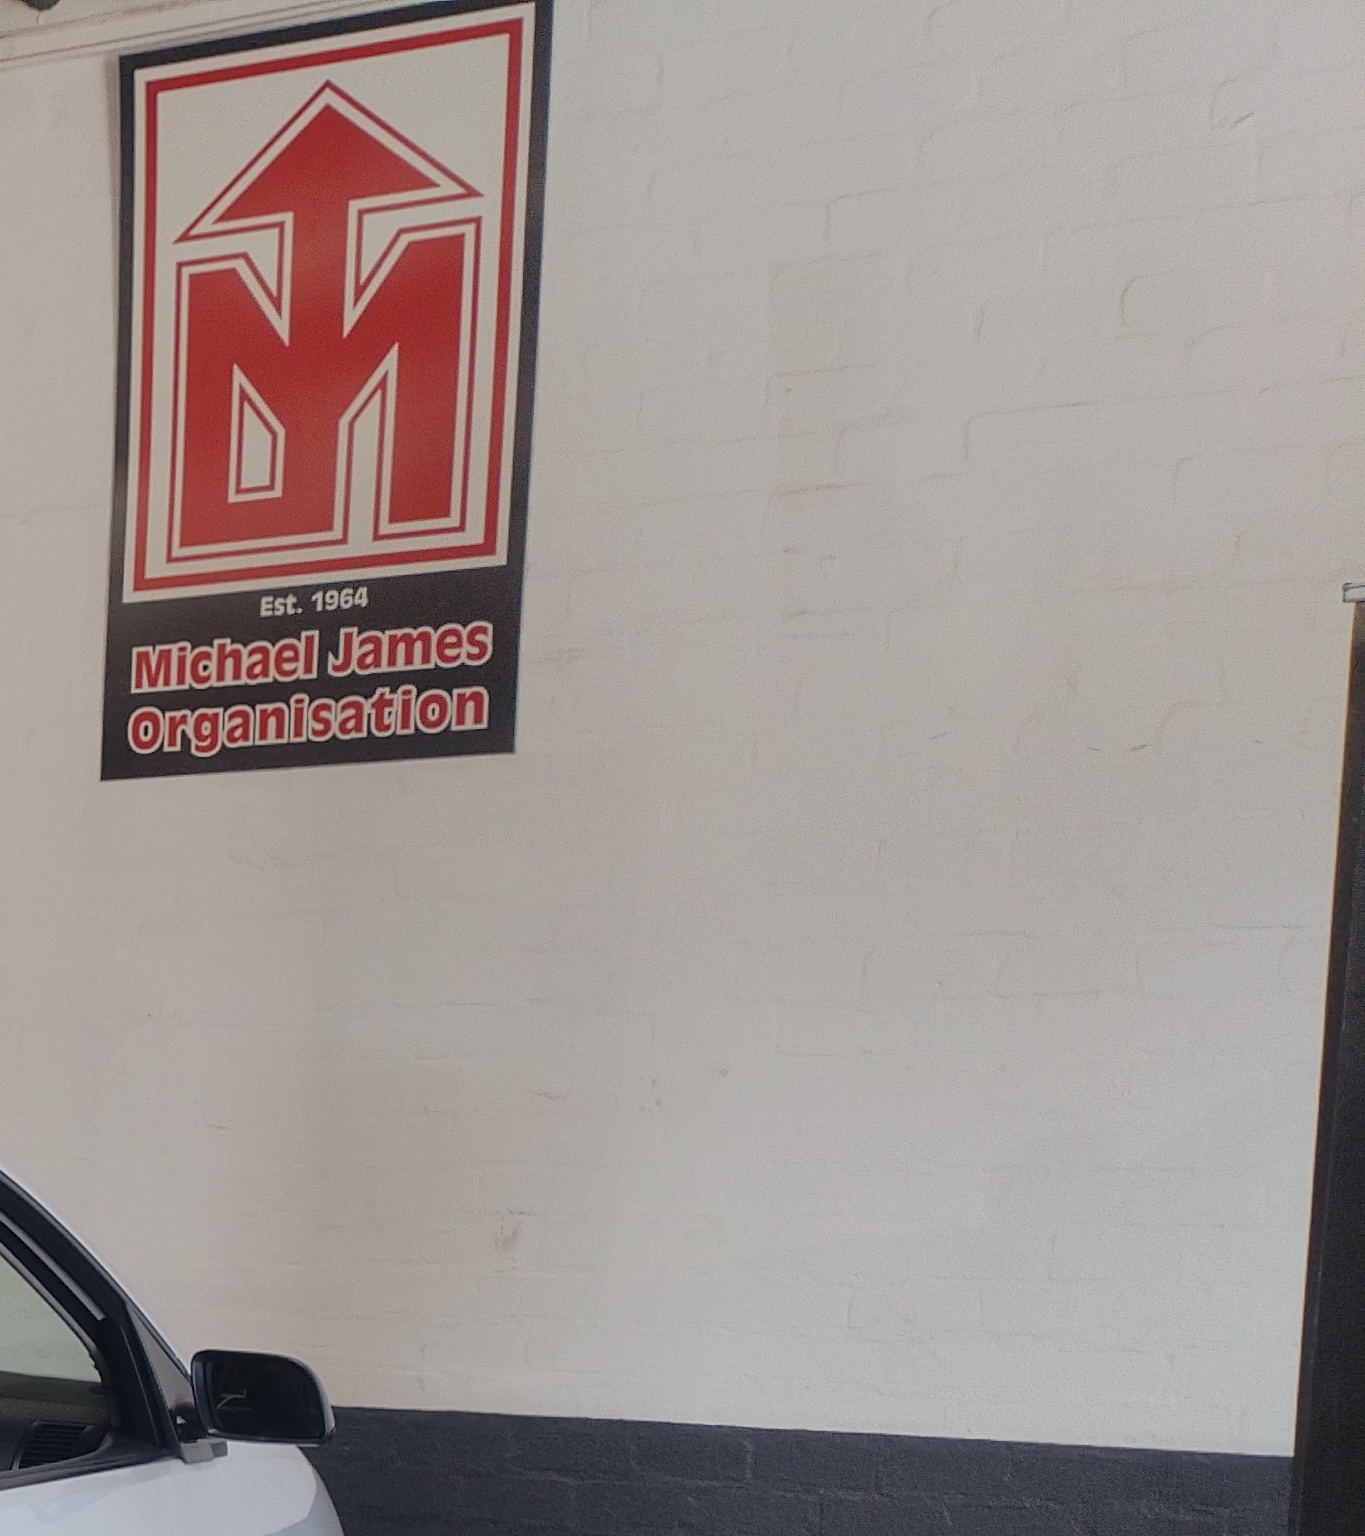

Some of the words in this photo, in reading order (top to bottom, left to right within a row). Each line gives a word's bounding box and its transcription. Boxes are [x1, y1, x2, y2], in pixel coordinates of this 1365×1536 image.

[259, 592, 303, 619] Est.
[310, 586, 369, 612] 1964
[130, 629, 320, 694] Michael
[327, 620, 493, 677] James
[127, 684, 489, 758] Organisation
